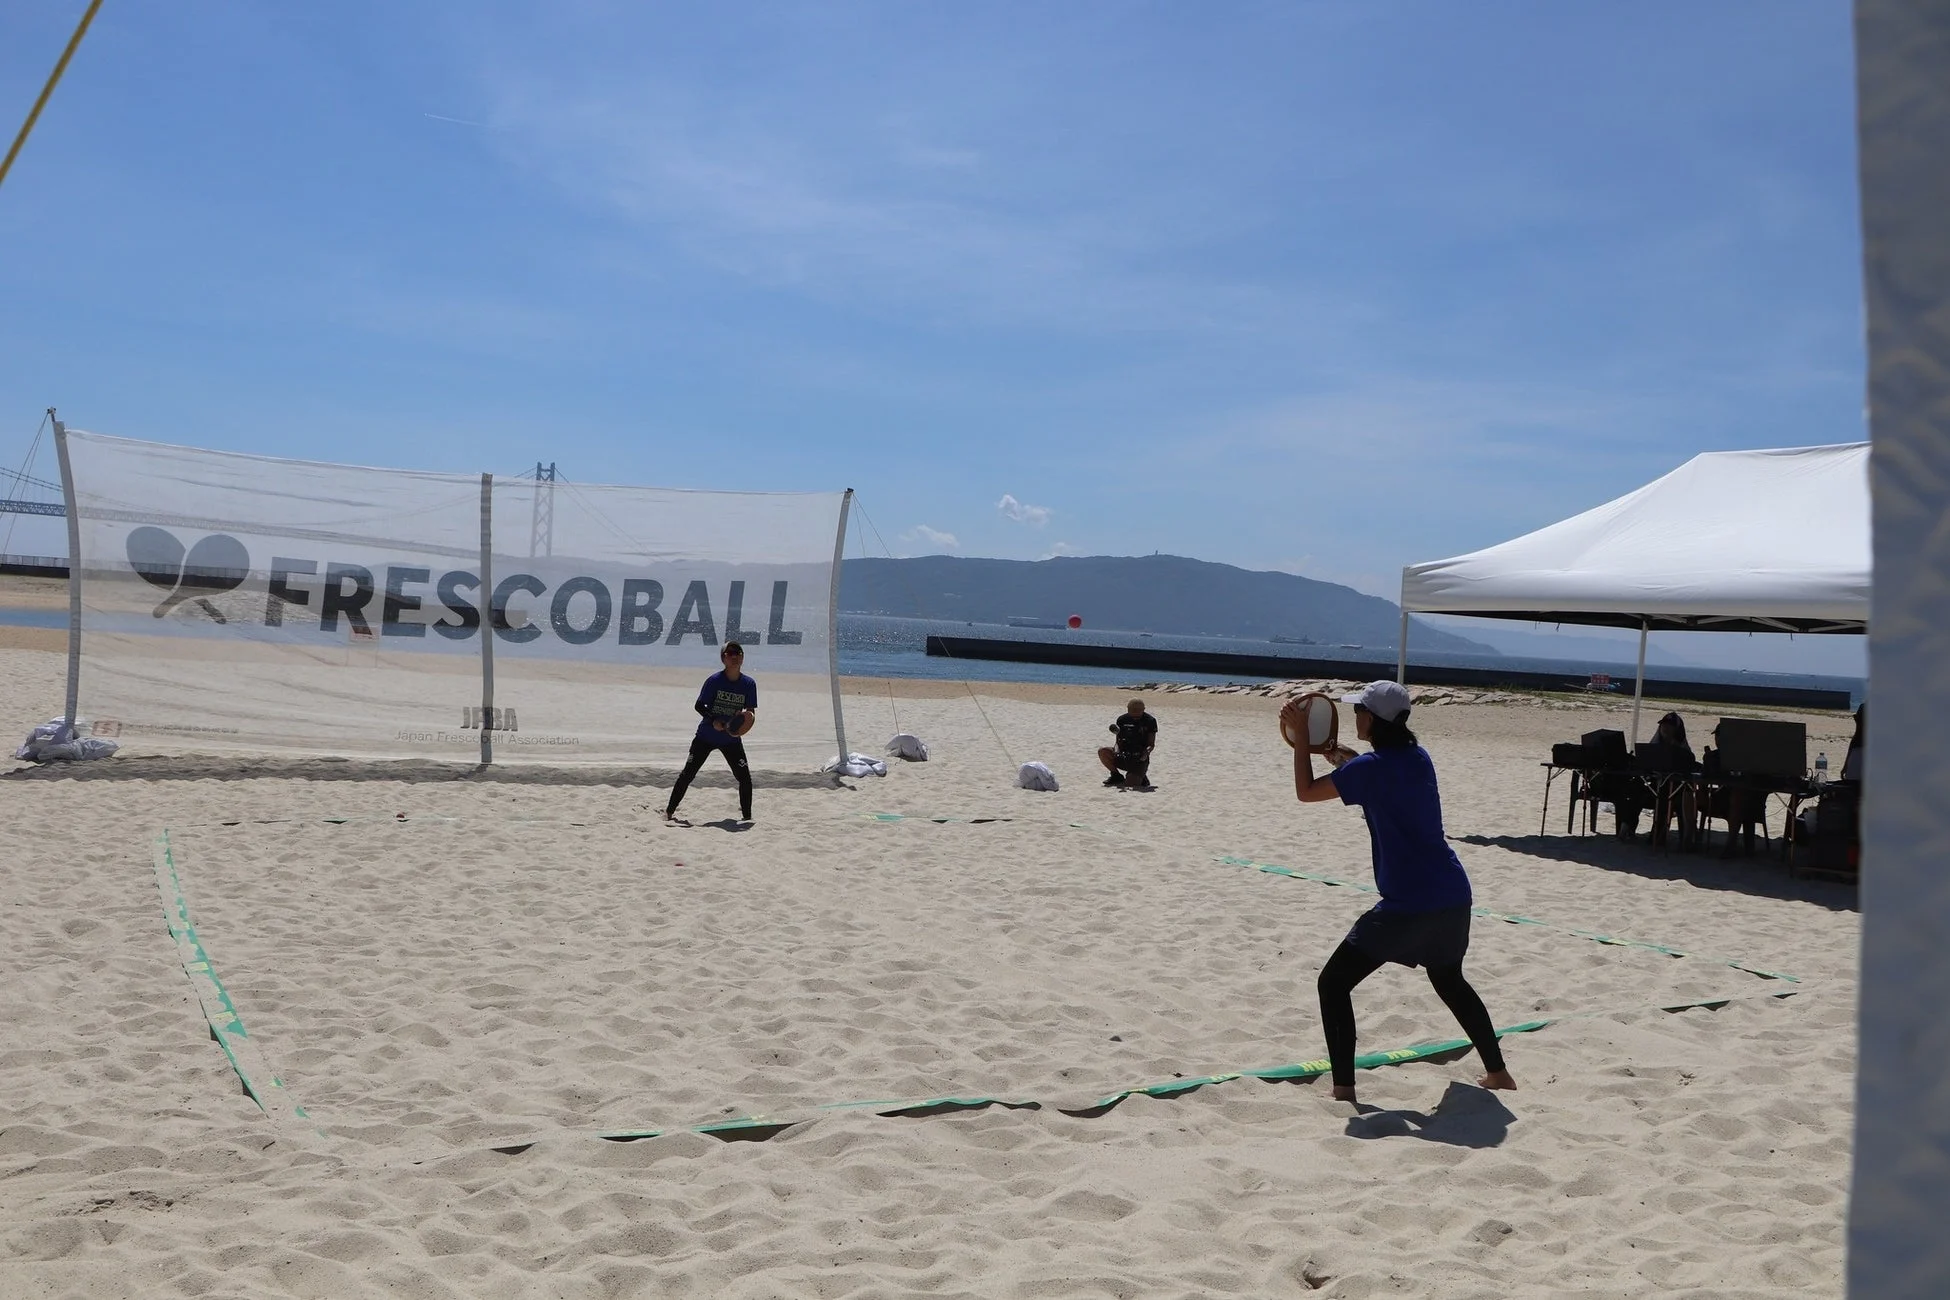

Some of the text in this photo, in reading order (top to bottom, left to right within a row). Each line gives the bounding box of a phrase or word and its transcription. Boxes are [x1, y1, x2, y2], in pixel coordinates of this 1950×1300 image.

[265, 556, 803, 647] FRESCOBALL
[460, 706, 519, 732] JFBA
[394, 731, 580, 746] Japan Frescoball Association
